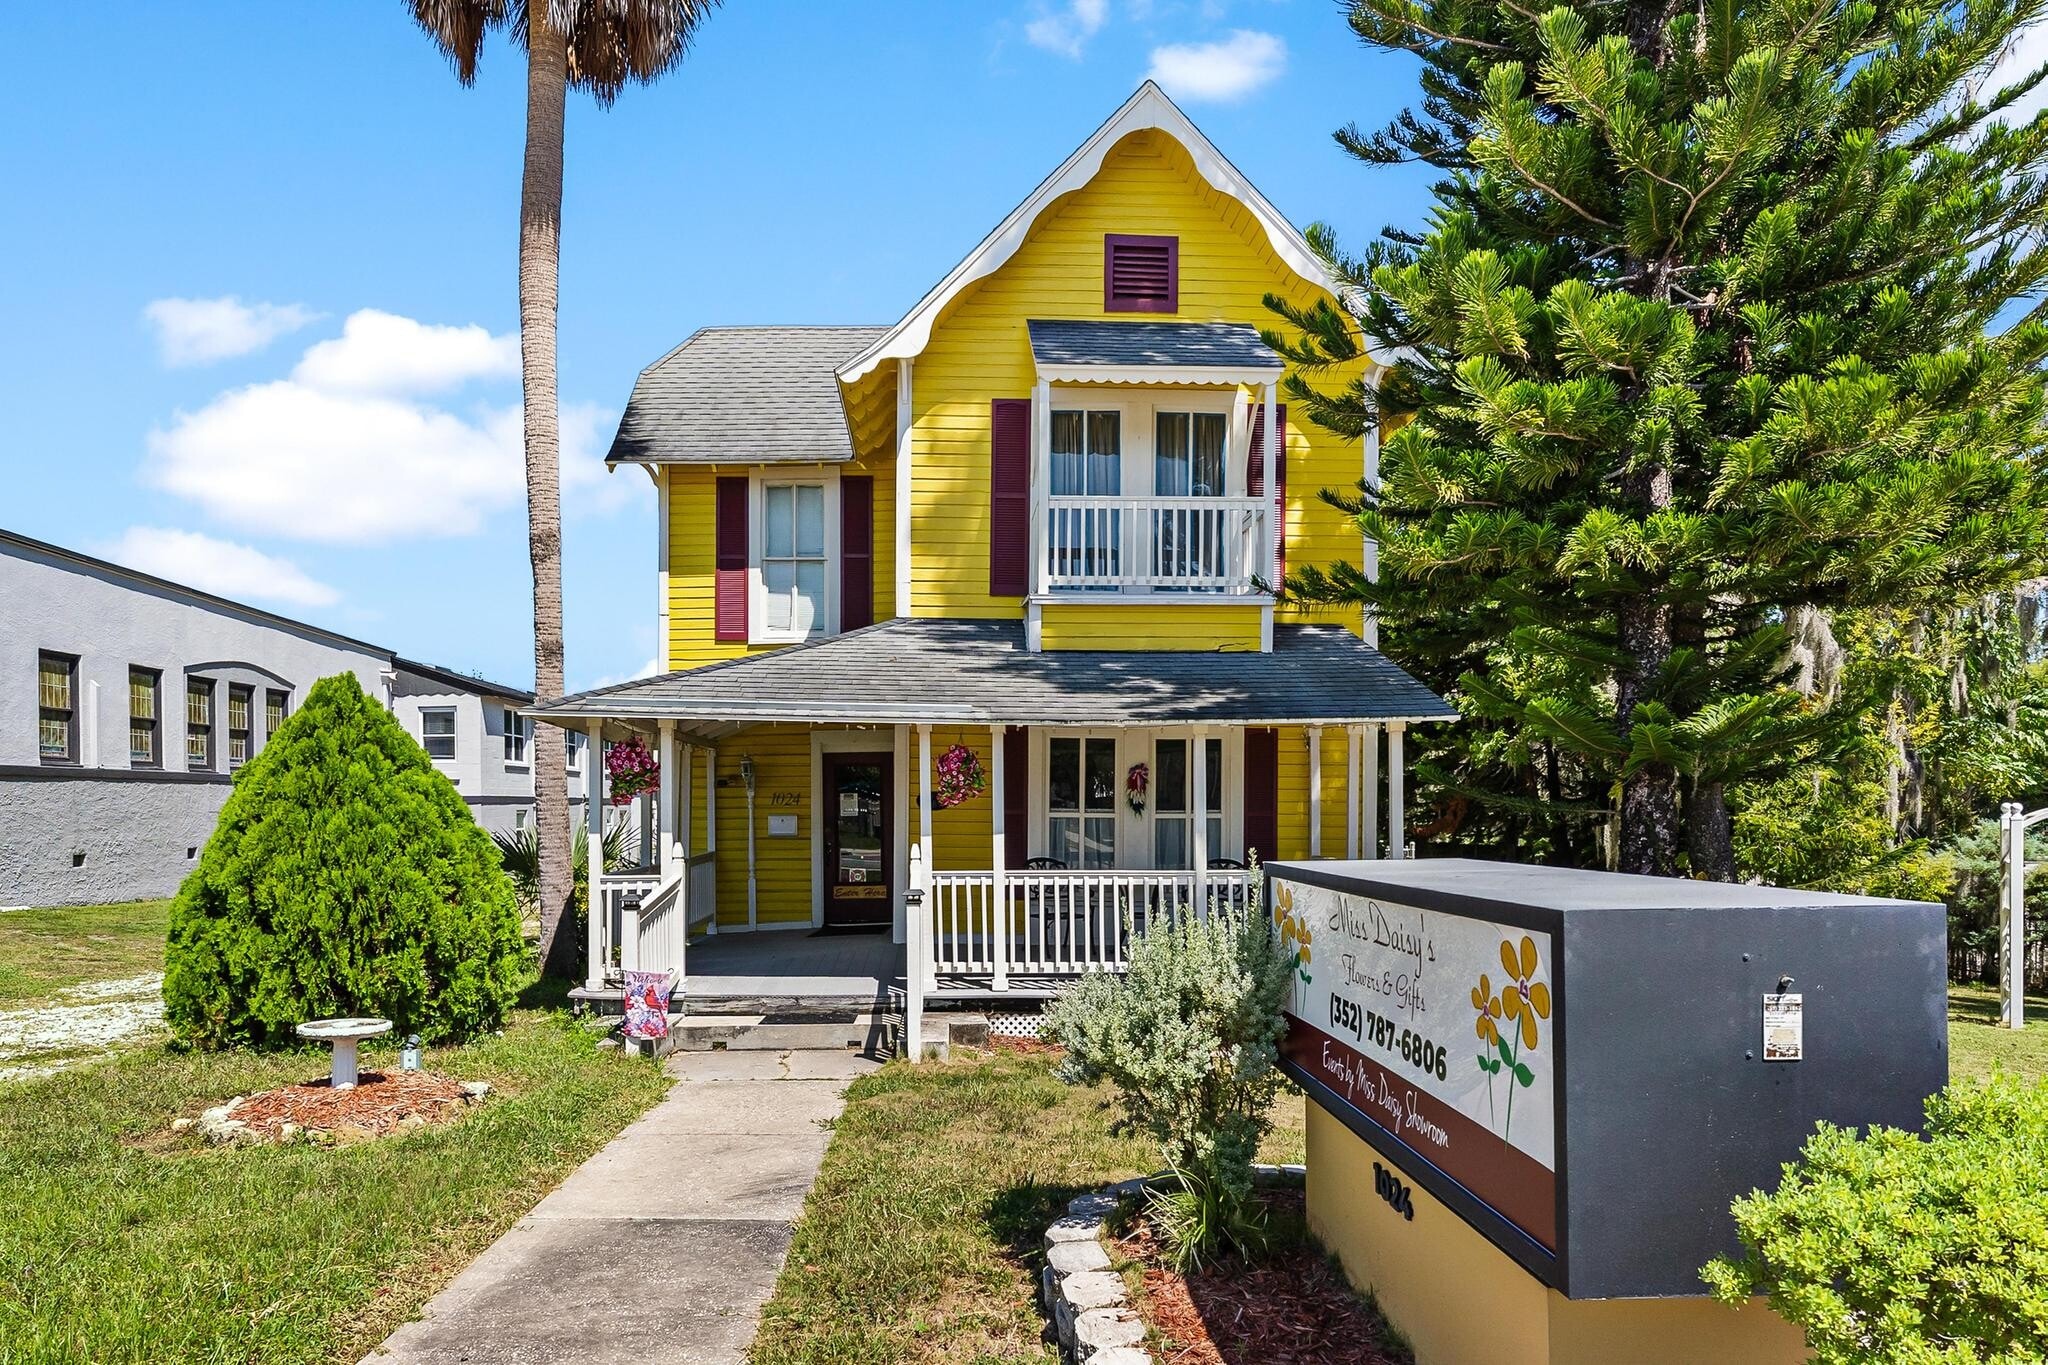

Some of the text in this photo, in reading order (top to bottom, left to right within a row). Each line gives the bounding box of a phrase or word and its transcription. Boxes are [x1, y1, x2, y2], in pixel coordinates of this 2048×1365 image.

[770, 793, 800, 806] 1024
[835, 888, 858, 898] Enter
[1328, 894, 1436, 979] Miss Daisy's
[1341, 953, 1426, 1022] Flowers & Gifts
[1330, 992, 1447, 1081] (352) 787-6806
[1322, 1040, 1449, 1149] Events by Miss Daisy Showroom
